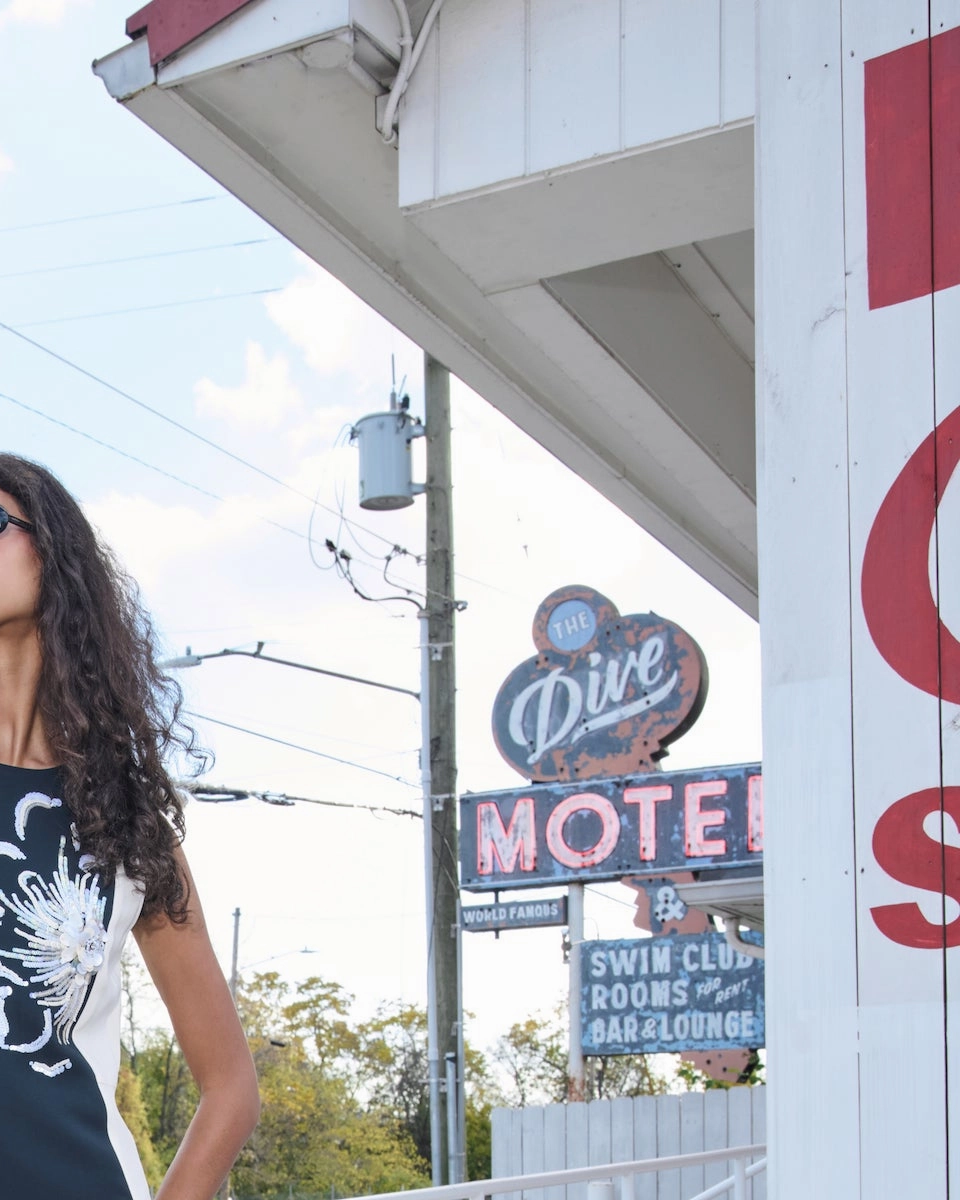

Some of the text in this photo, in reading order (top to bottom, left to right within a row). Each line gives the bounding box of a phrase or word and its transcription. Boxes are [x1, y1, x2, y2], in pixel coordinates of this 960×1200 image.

[553, 611, 589, 639] THE
[508, 636, 666, 764] Dive
[462, 903, 559, 923] WORLD FAMOUS
[654, 885, 686, 922] &
[591, 945, 671, 977] SWIM
[591, 977, 749, 1010] ROOMS FOR RENT
[591, 1009, 754, 1044] BAR & LOUNGE
